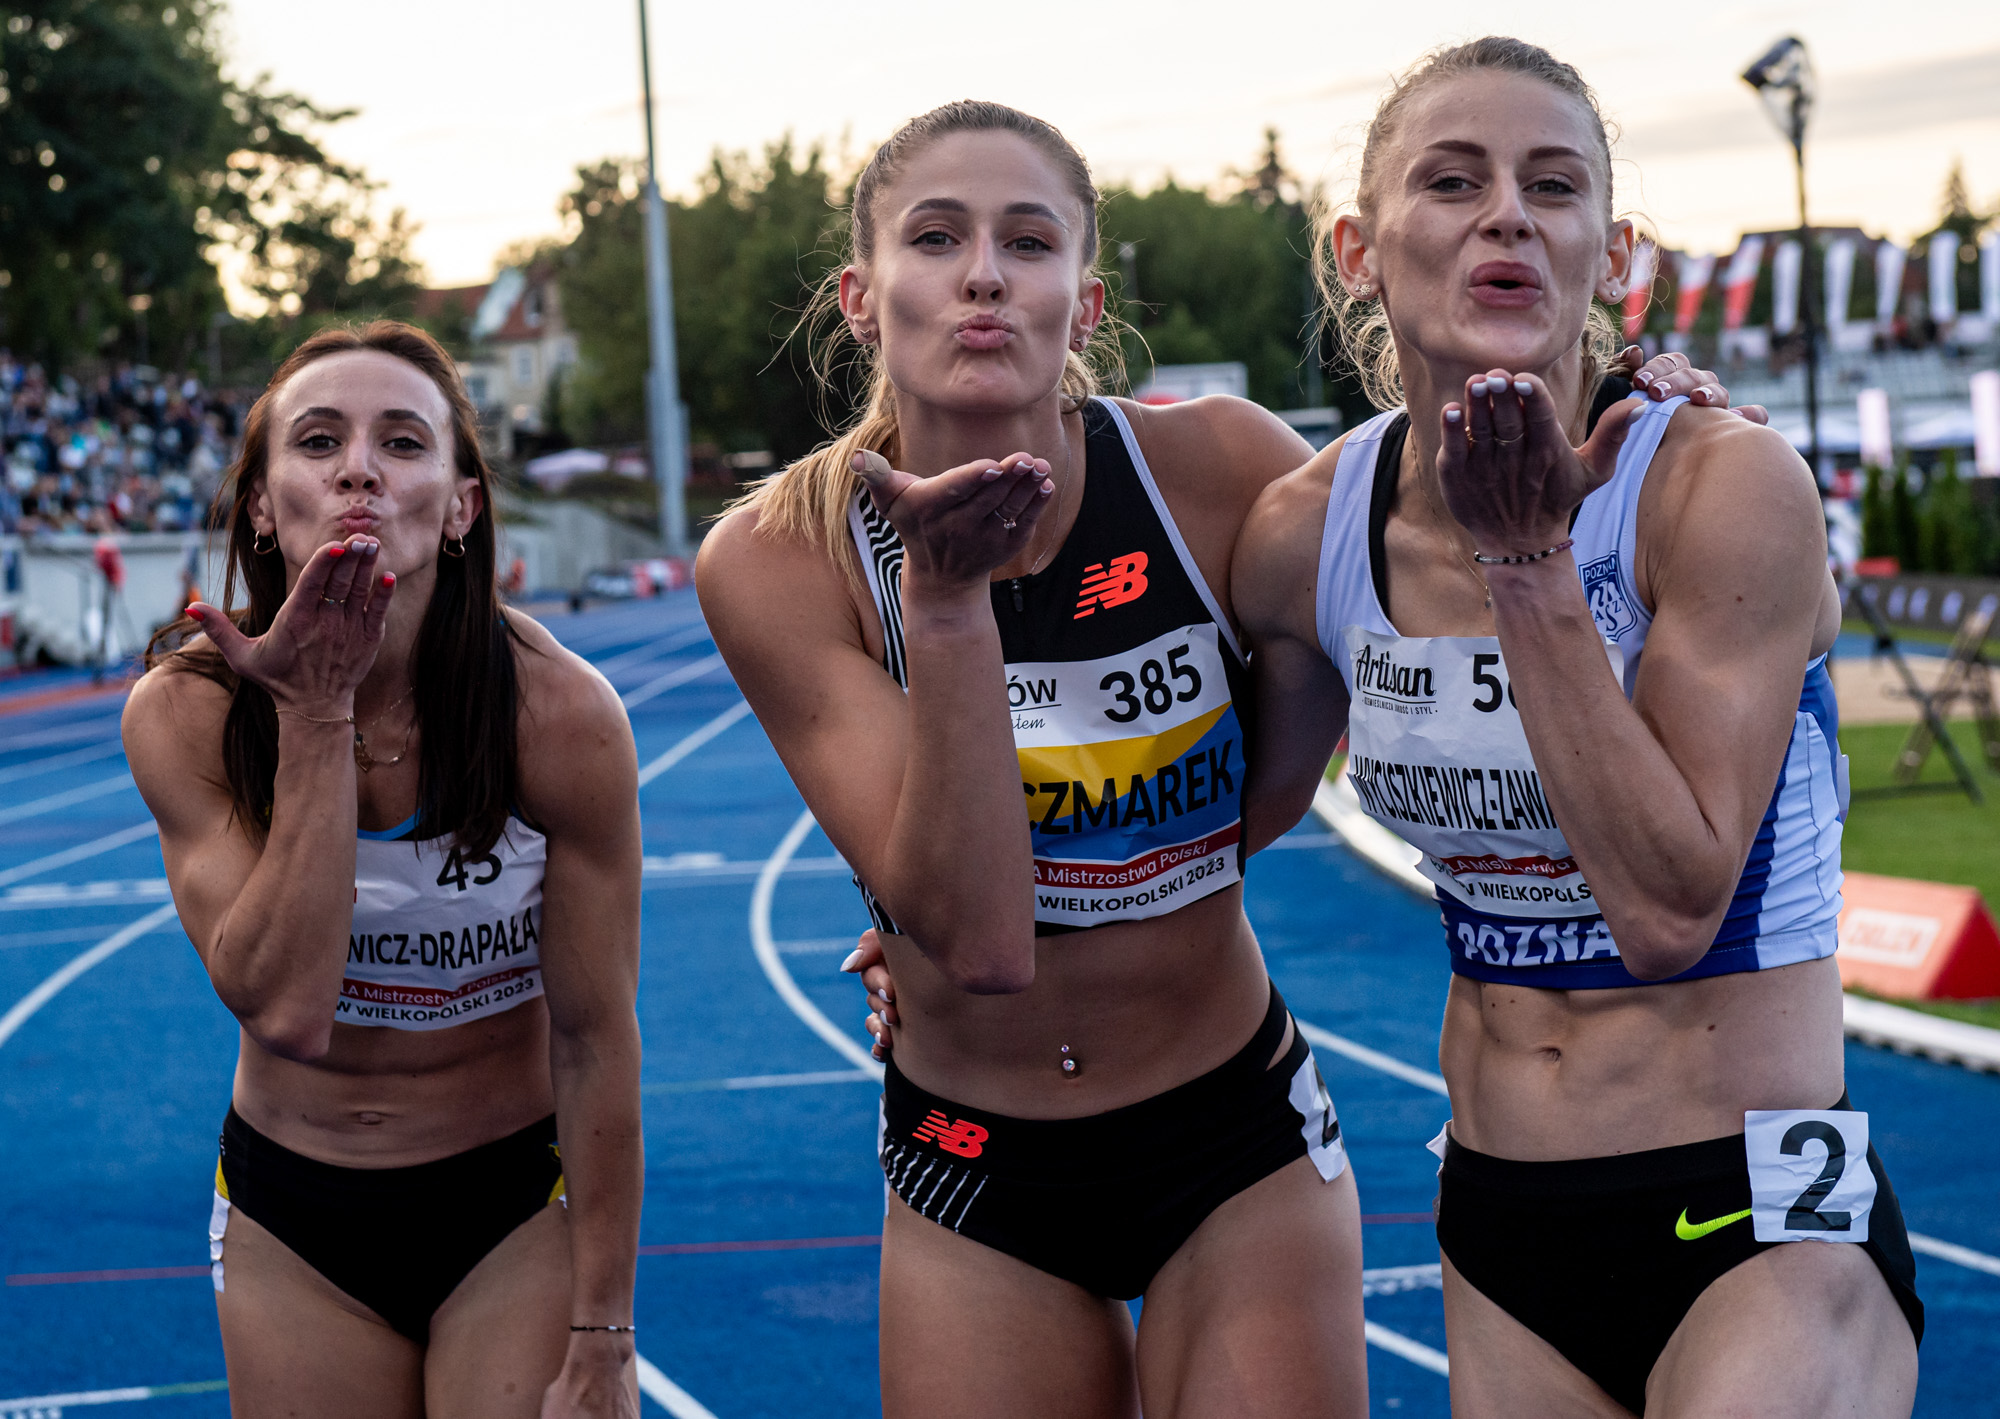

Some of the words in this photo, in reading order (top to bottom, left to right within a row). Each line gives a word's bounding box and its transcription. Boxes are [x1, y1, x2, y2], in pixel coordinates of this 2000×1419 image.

[1007, 675, 1056, 707] ÓW
[1099, 643, 1202, 723] 385
[1354, 644, 1437, 697] Artisan
[1472, 654, 1518, 713] 5
[1011, 713, 1046, 729] tem
[1415, 706, 1433, 715] STYL
[1354, 754, 1558, 831] WYCISZKIEWICZ-ZAW
[1038, 876, 1184, 912] WIELKOPOLSKI
[1186, 857, 1225, 886] 2023
[1048, 861, 1157, 885] Mistrzostwa
[1160, 841, 1208, 869] Polski
[356, 994, 490, 1021] WIELKOPOLSKI
[493, 978, 534, 1002] 2023
[1780, 1120, 1846, 1231] 2
